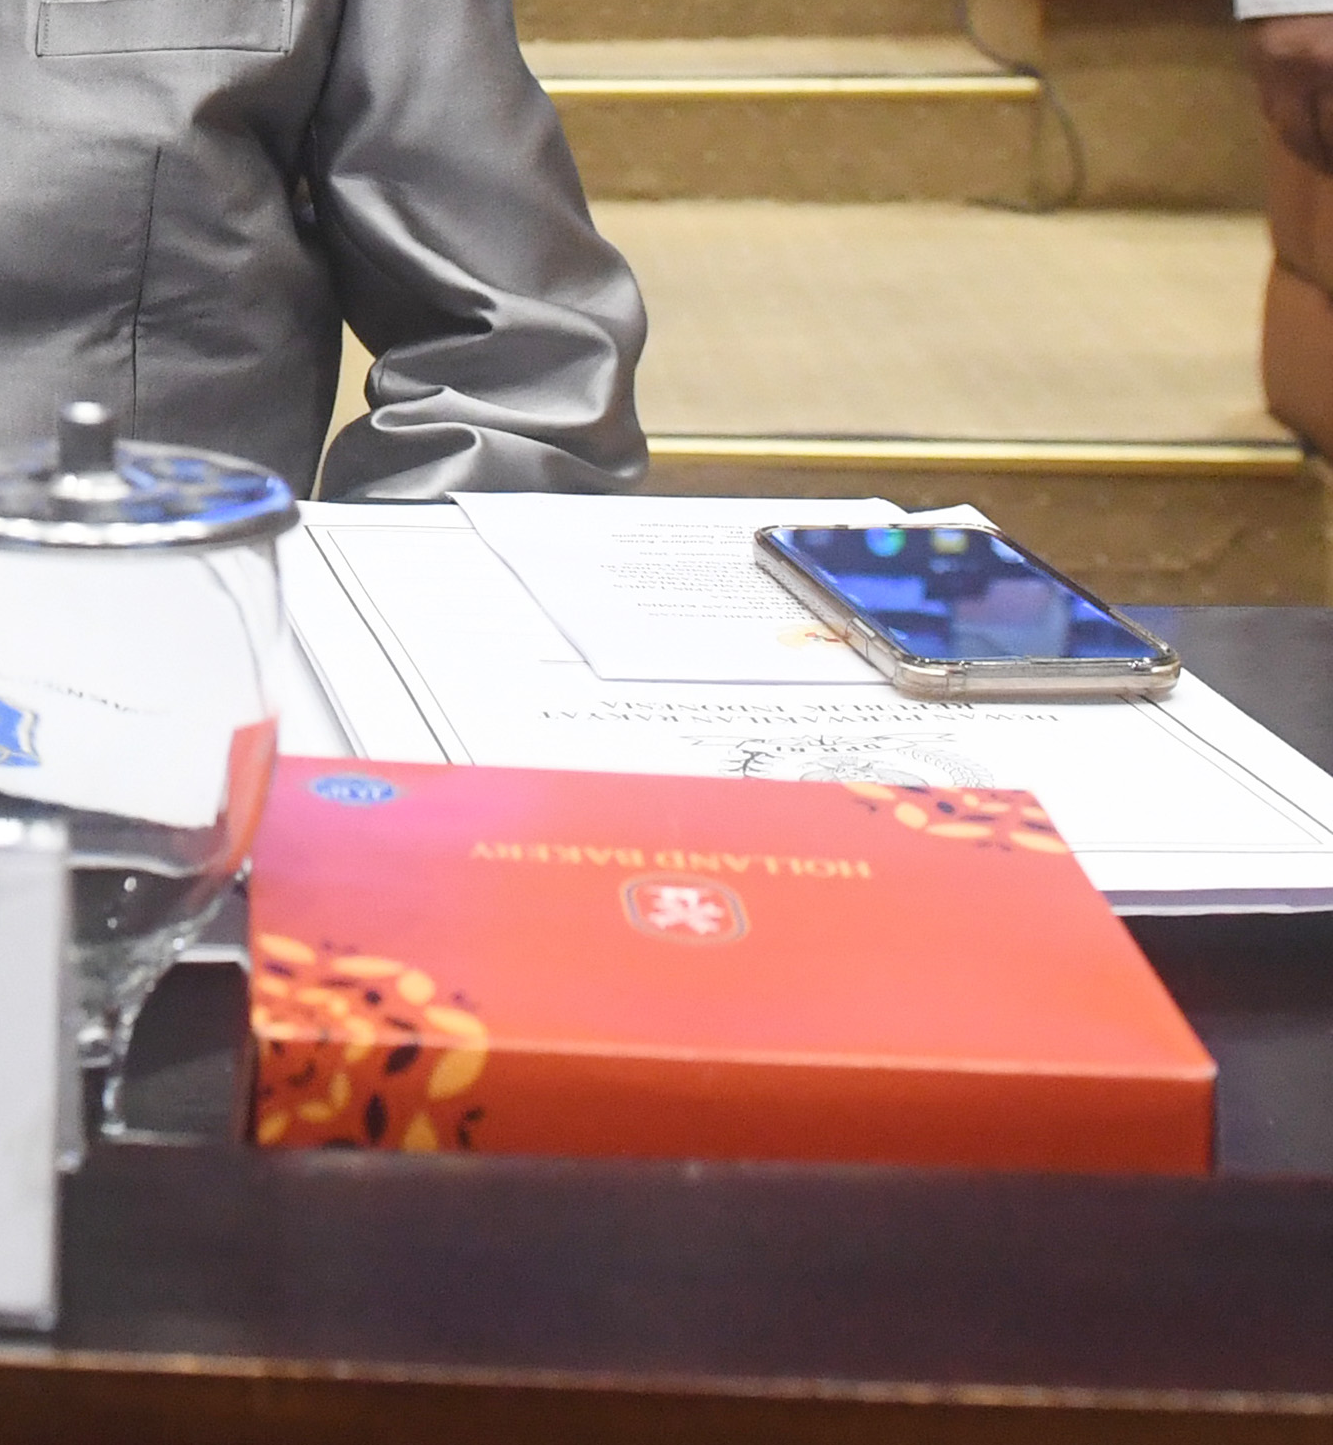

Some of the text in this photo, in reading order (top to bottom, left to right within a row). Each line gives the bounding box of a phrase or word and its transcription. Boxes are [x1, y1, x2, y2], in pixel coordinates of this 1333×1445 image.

[600, 700, 975, 713] REPUBLIK INDONESIA
[537, 710, 1060, 724] DEWAN PERWAKILAN RAKYAT
[823, 743, 883, 753] DPR
[471, 841, 873, 880] HOLLAND BAKERY
